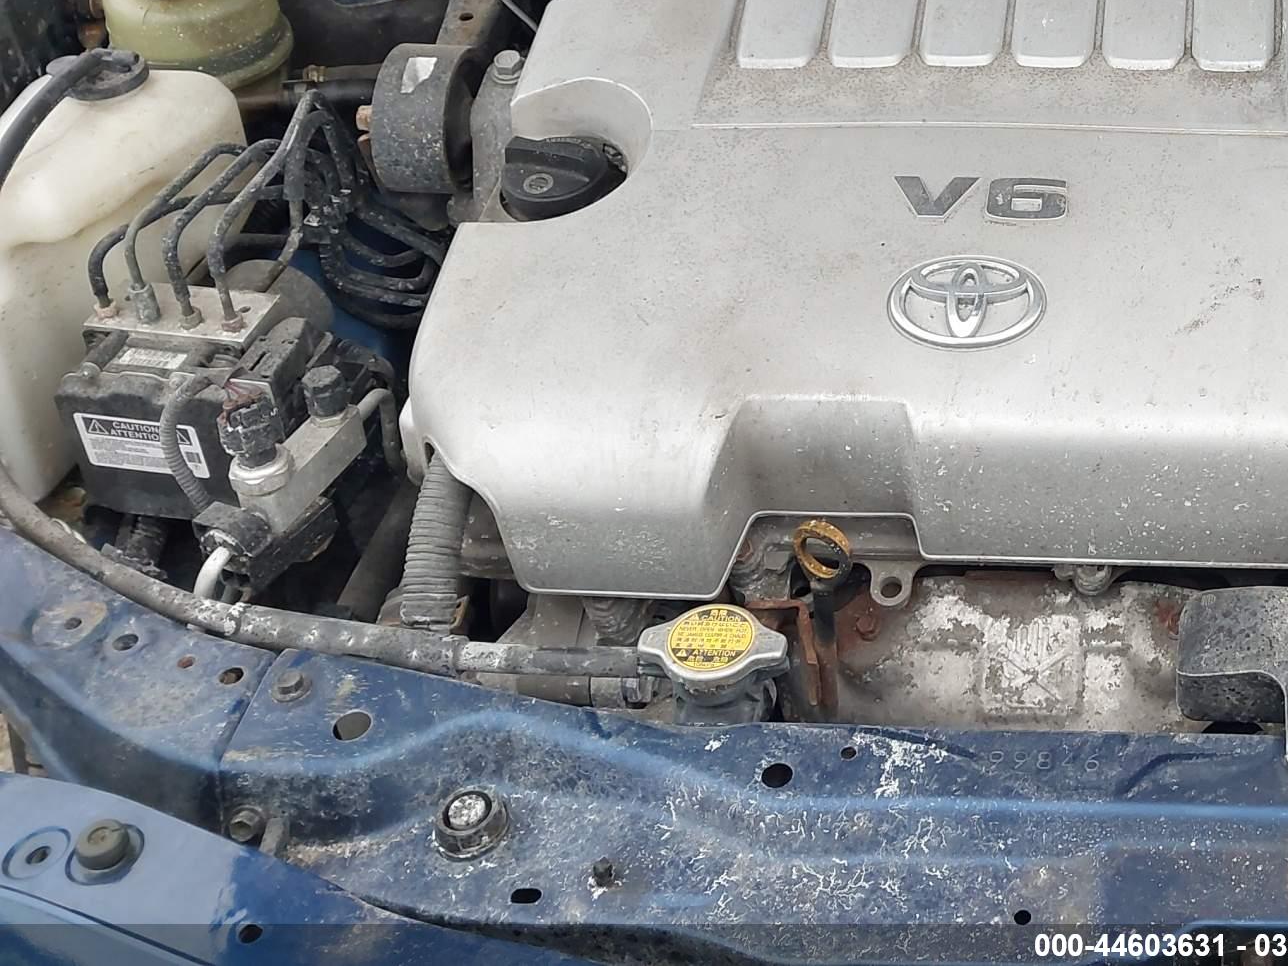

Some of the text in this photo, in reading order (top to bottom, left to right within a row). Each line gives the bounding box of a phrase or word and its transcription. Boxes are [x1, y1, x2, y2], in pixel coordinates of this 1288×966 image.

[893, 175, 1068, 220] V6
[112, 421, 160, 434] CAUTION
[110, 428, 160, 441] ATTENTIO
[701, 614, 741, 622] CAUTION
[692, 649, 736, 657] ATTENTION
